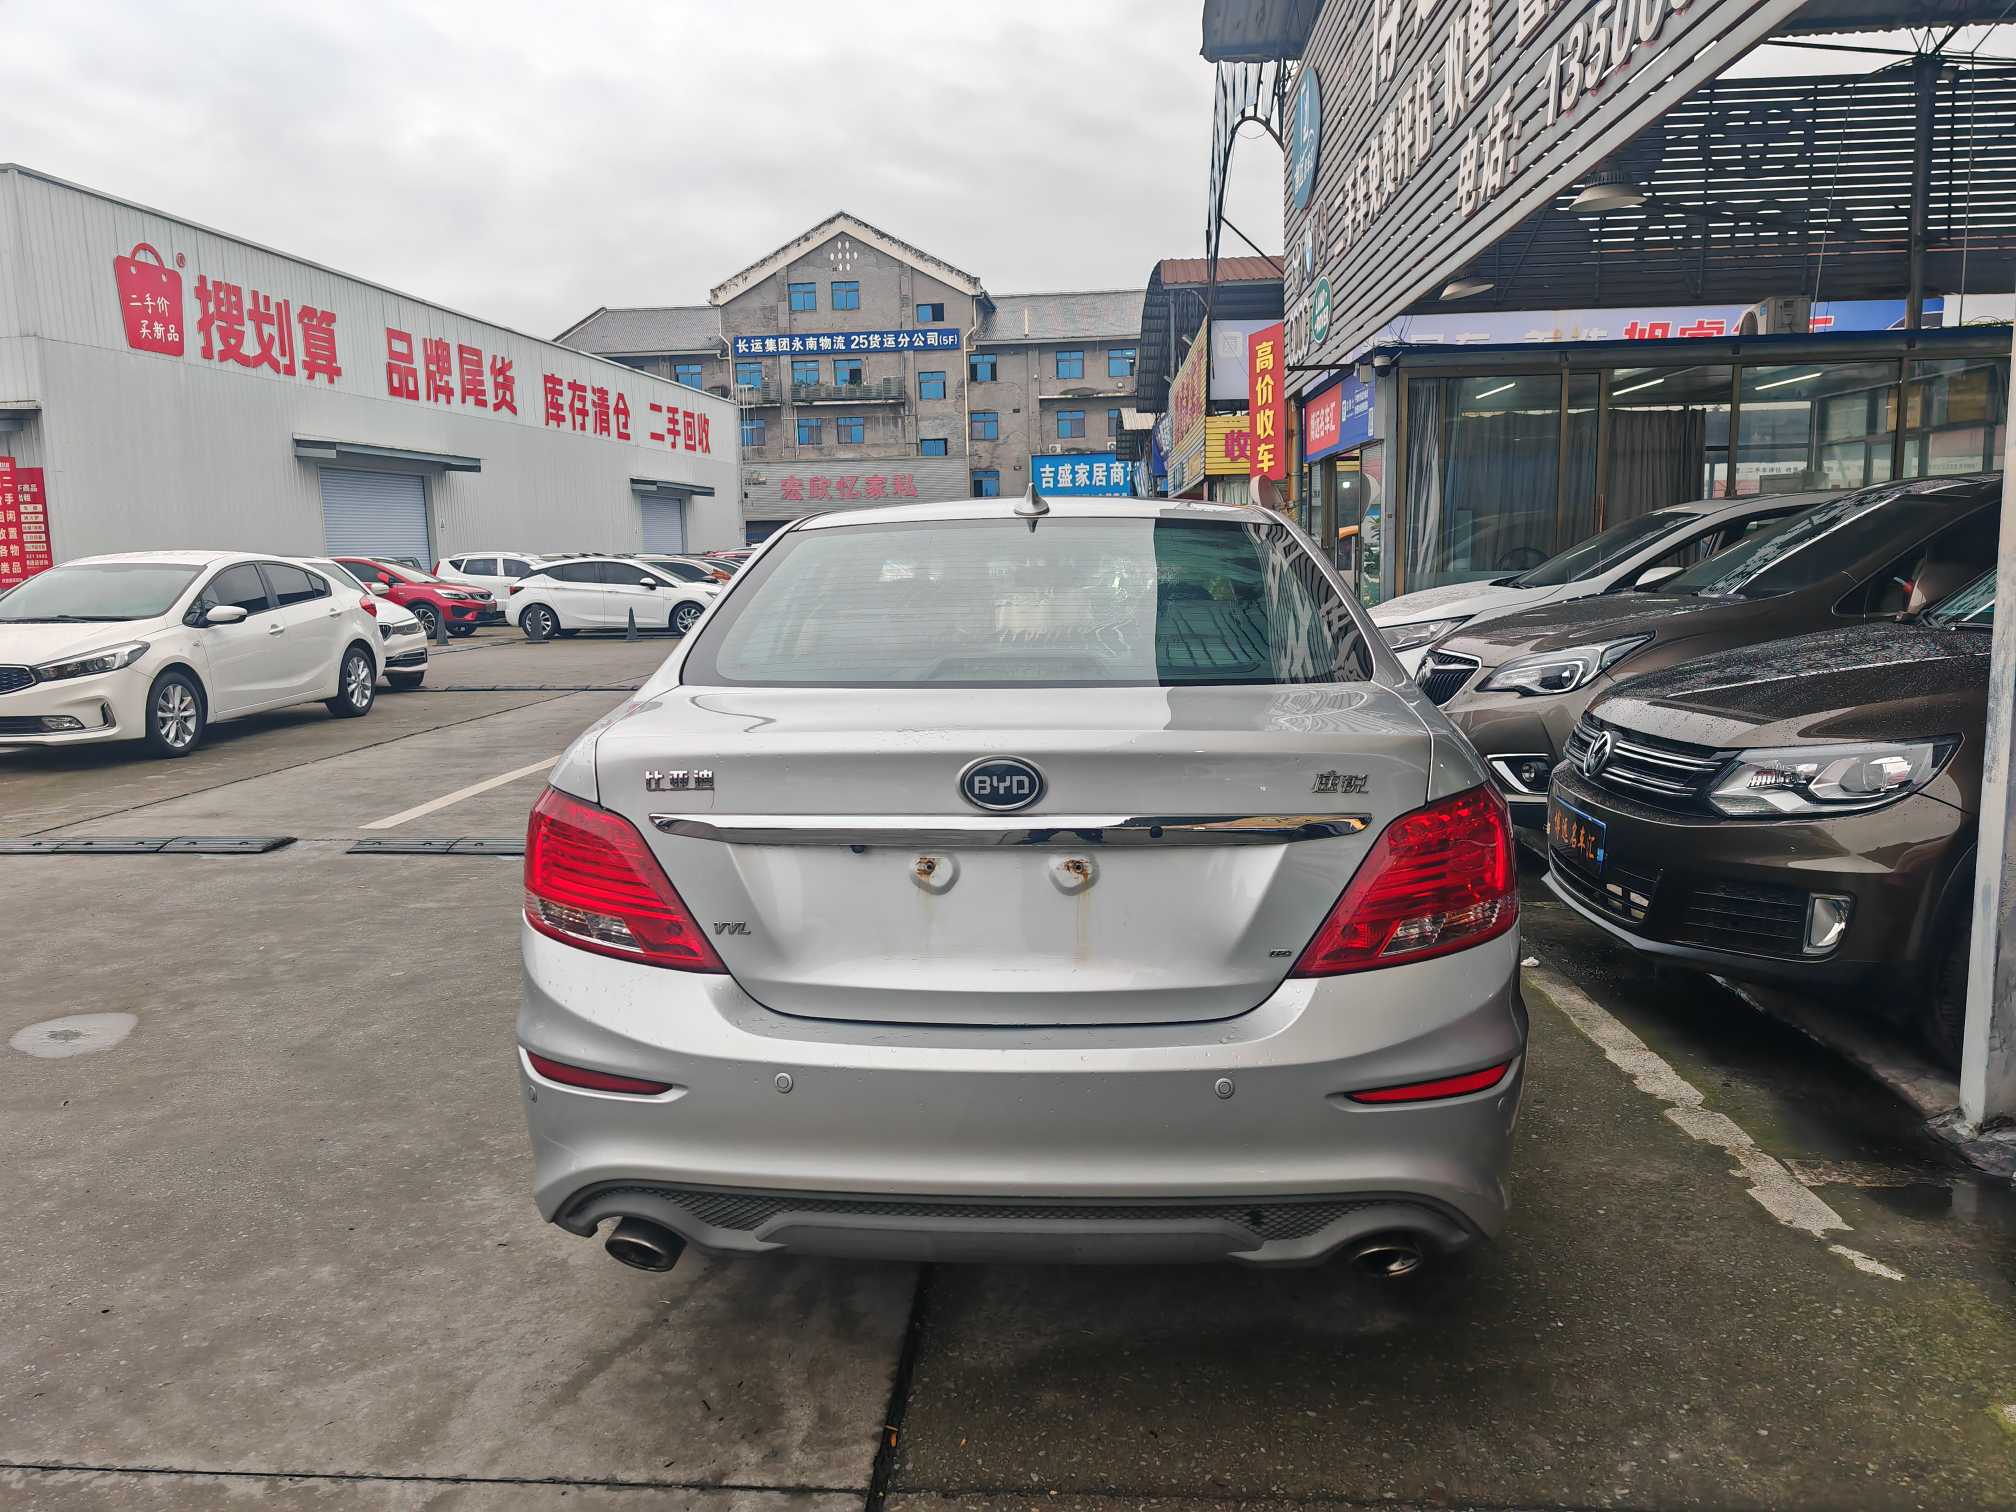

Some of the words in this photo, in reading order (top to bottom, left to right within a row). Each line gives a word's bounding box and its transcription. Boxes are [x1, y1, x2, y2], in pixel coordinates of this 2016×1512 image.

[128, 294, 170, 316] 二手价
[139, 320, 180, 343] 买新品
[195, 273, 342, 384] 搜划算
[736, 336, 846, 354] 长运集团永南物流
[386, 327, 518, 416] 品牌尾货
[543, 373, 631, 441] 库存清仓
[1255, 340, 1276, 473] 高价收车
[649, 402, 712, 454] 二手回收
[645, 769, 715, 790] 比亚迪
[973, 775, 1030, 795] BYD
[713, 920, 752, 936] VVL
